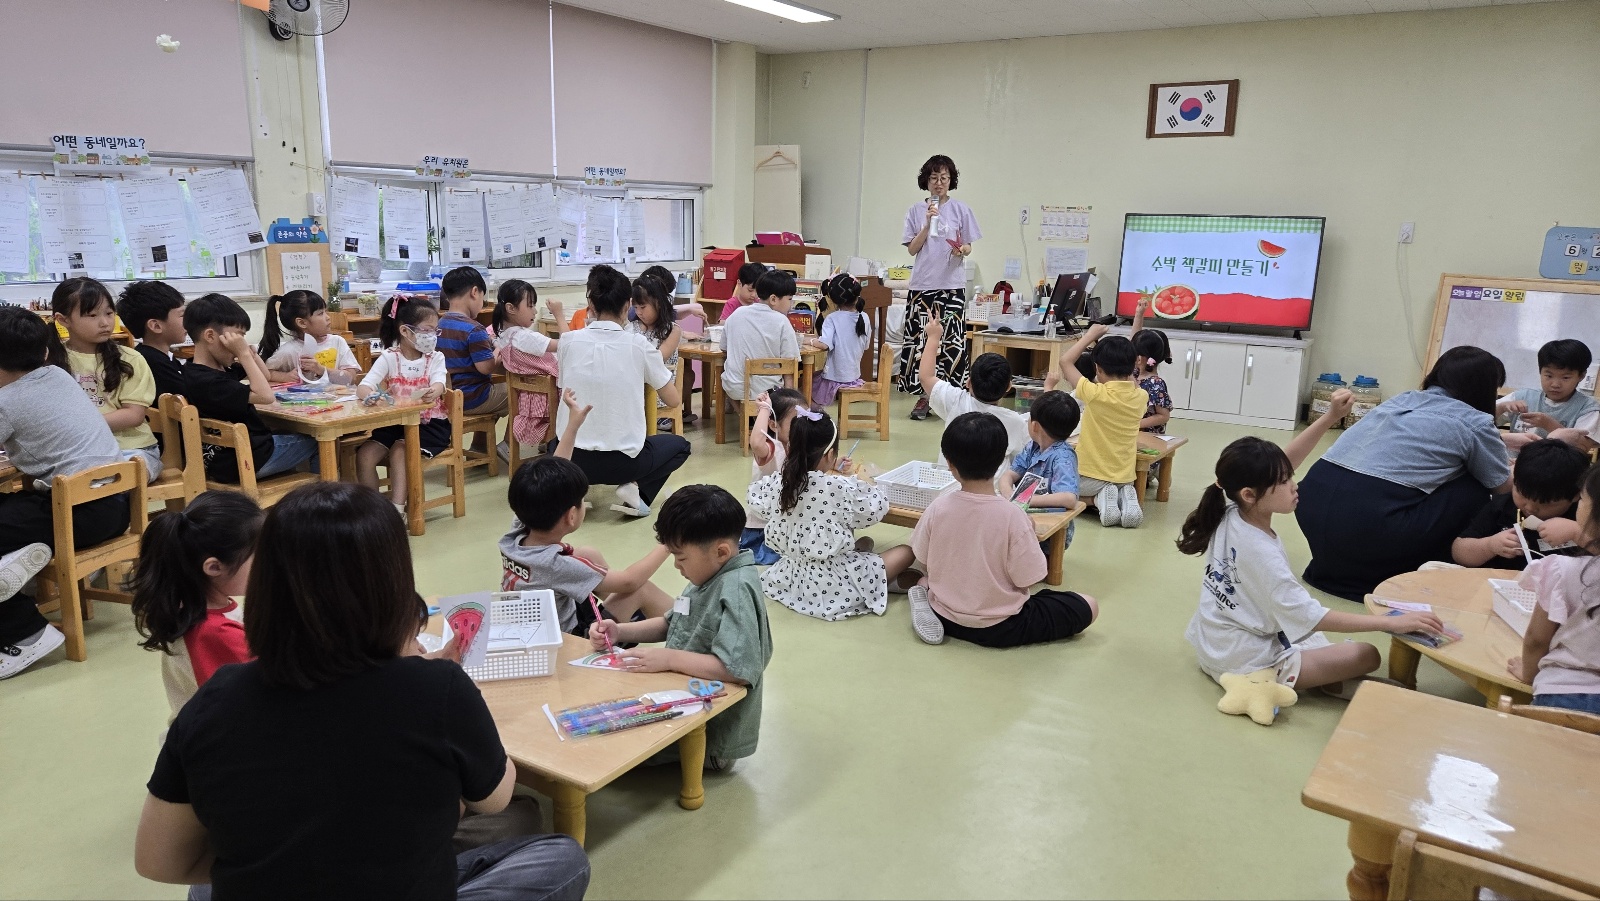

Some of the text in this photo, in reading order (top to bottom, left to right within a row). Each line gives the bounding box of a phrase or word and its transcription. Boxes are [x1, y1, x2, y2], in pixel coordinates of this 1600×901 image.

[53, 135, 146, 149] 어떤 동네일까요?
[423, 155, 469, 169] 우리 유치원은
[585, 166, 596, 175] 어떤
[295, 230, 308, 239] 약속
[1152, 255, 1269, 277] 수박 책갈피 만들기
[1482, 289, 1503, 299] 요일
[1504, 291, 1524, 301] 알림
